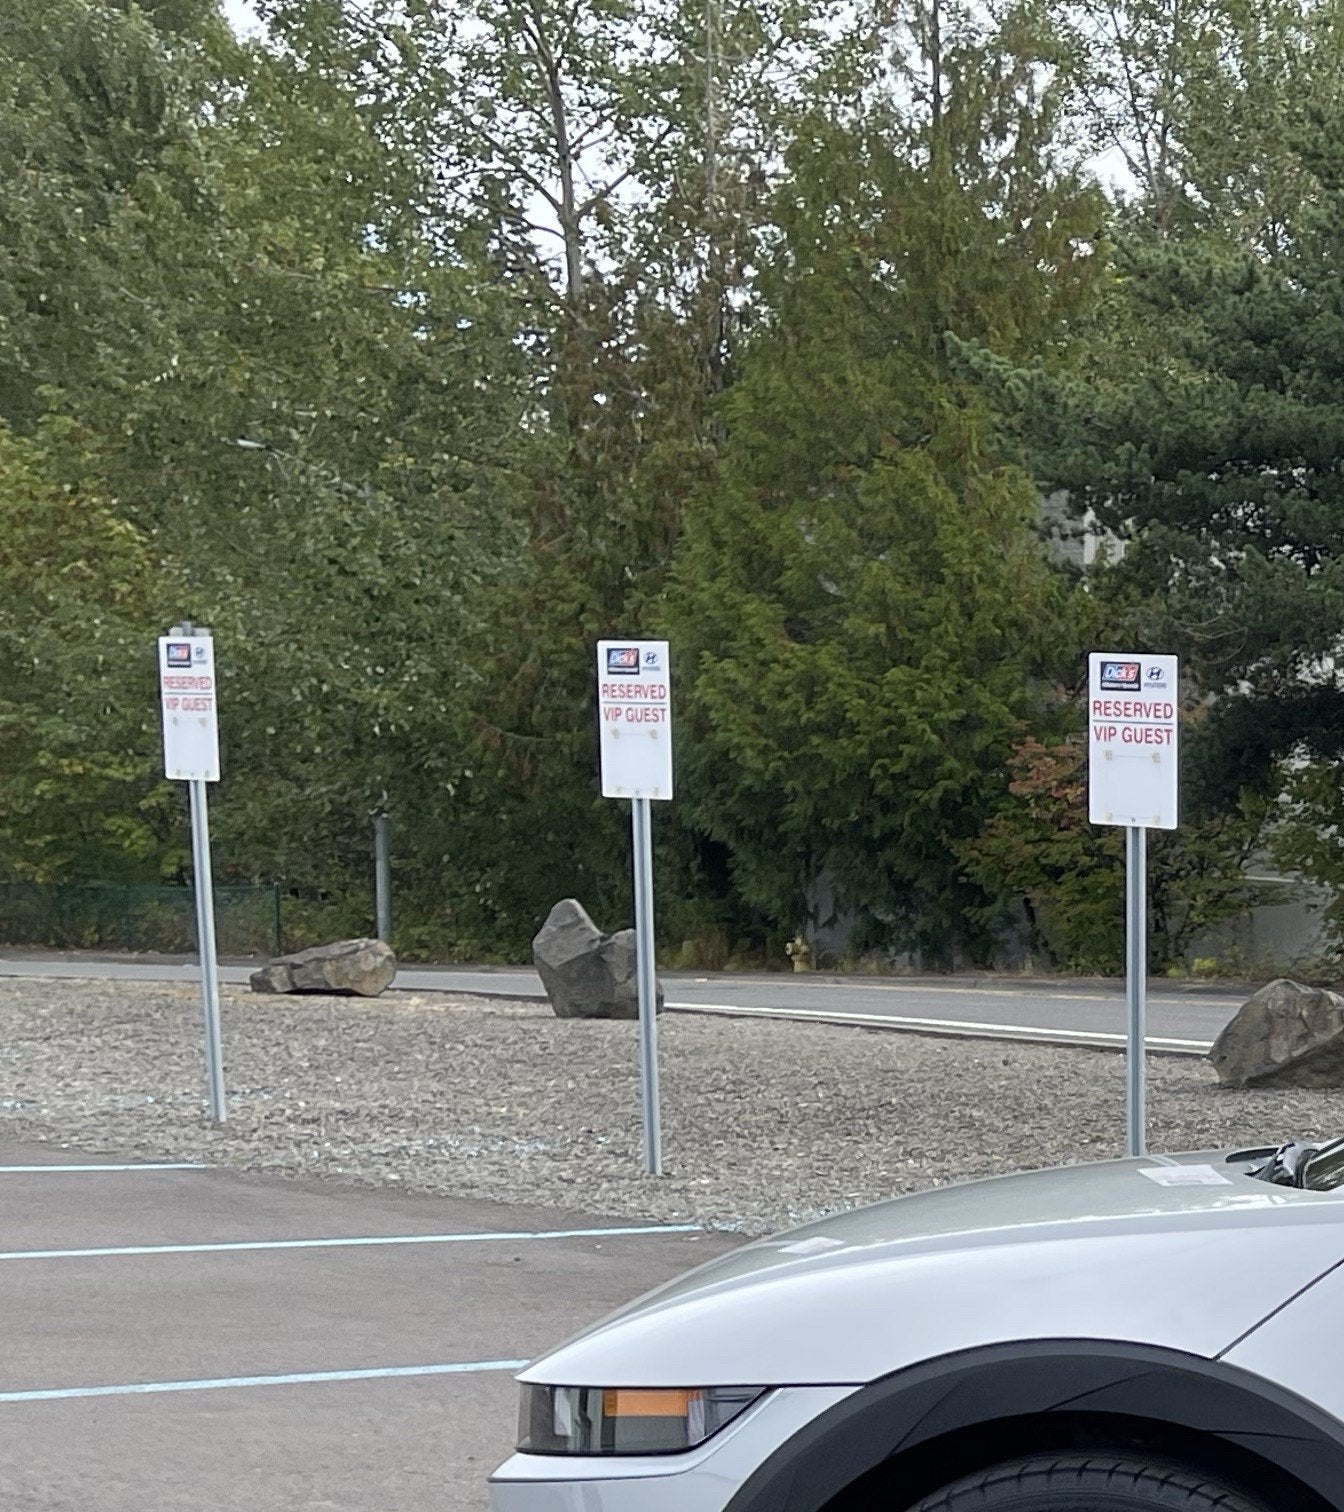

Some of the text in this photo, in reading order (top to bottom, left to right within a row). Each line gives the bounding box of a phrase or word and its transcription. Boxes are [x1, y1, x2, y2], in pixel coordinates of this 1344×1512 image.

[602, 683, 667, 699] RESERVED
[603, 707, 667, 723] VIP GUEST
[1093, 701, 1173, 719] RESERVED
[1094, 726, 1173, 745] VIP GUEST
